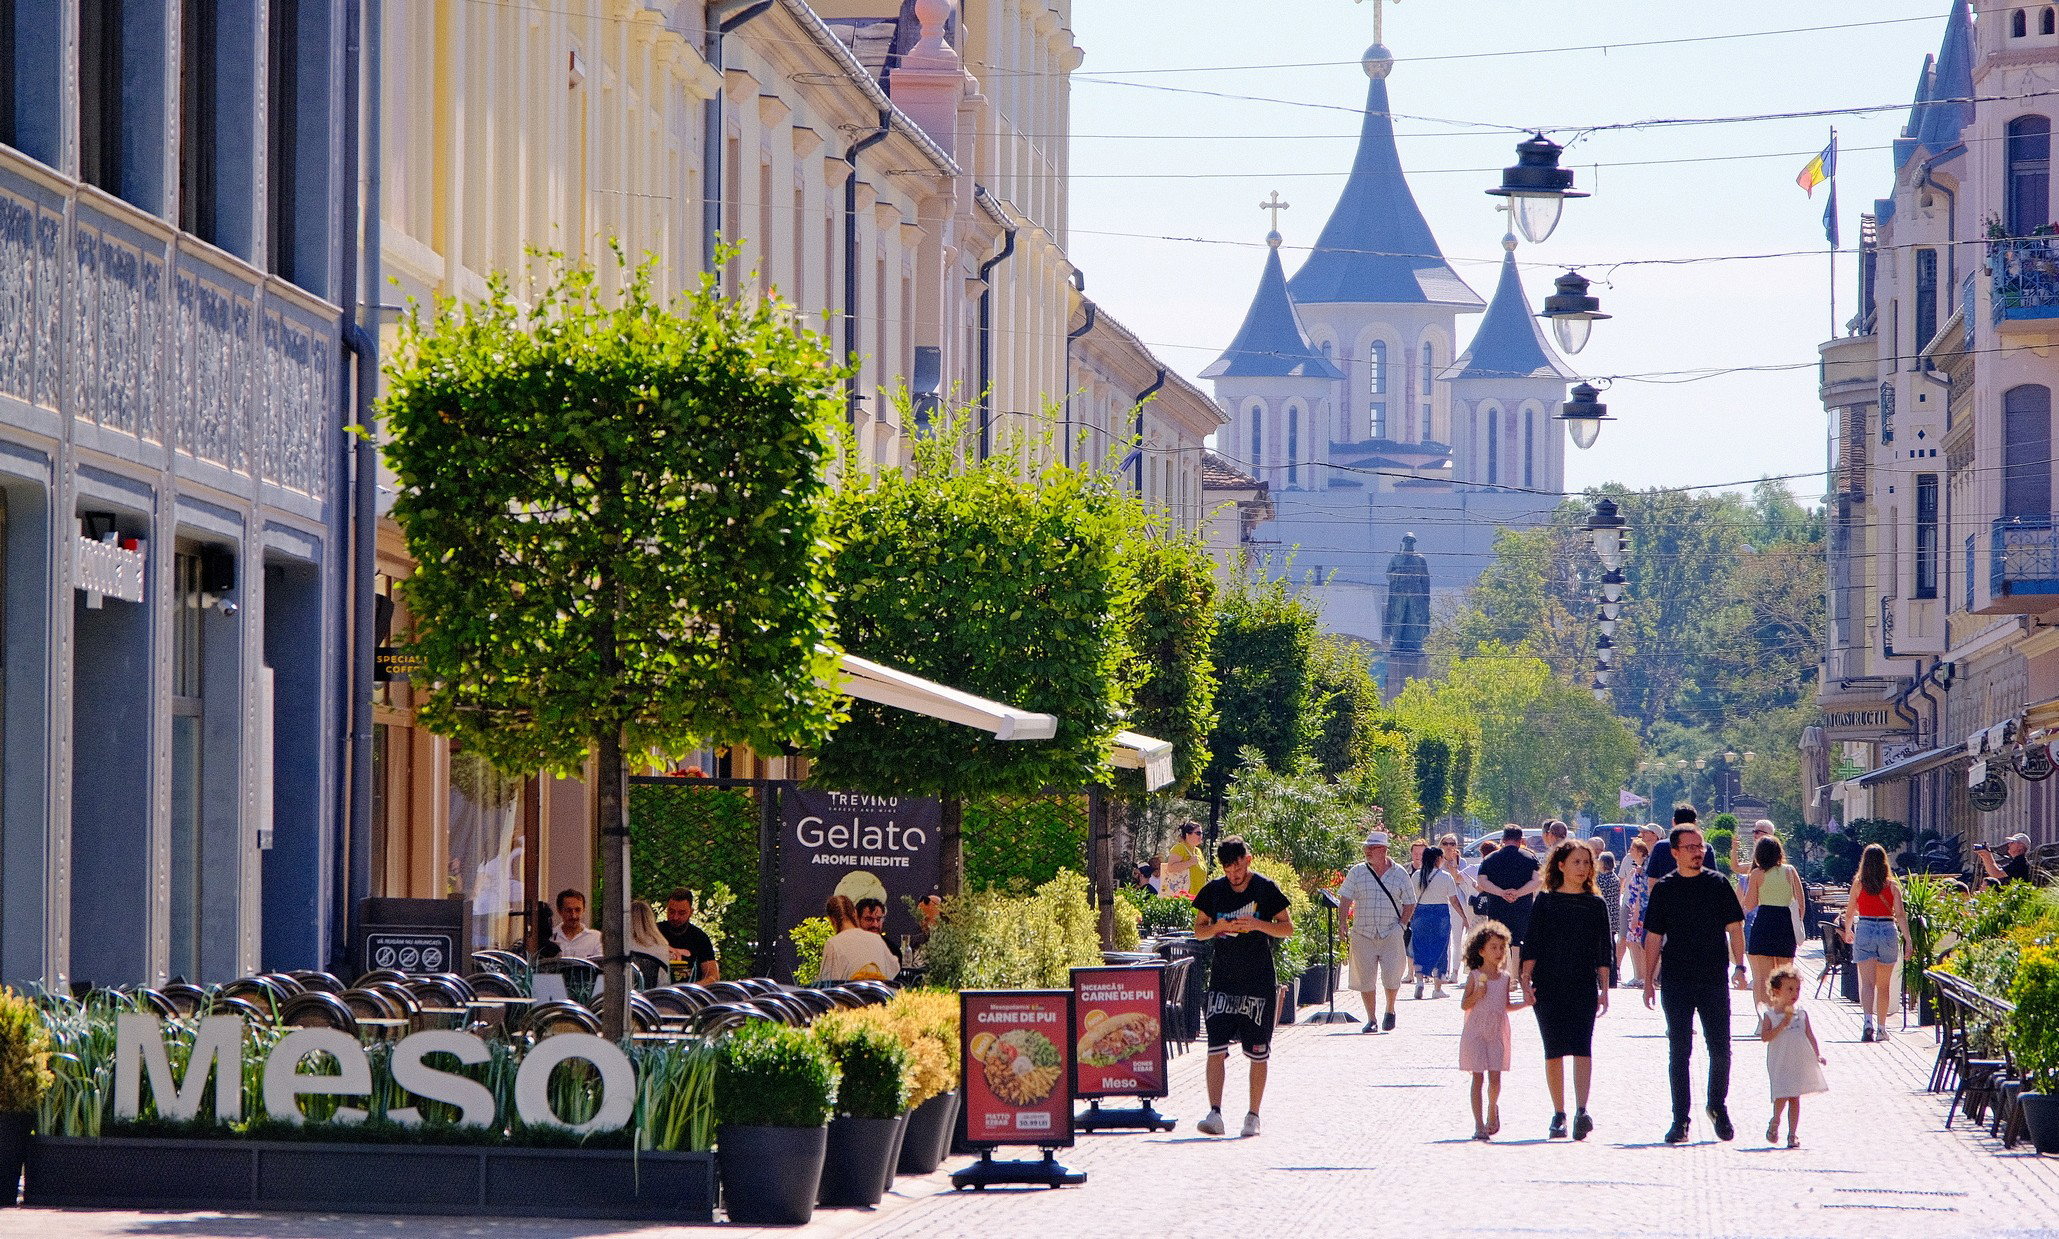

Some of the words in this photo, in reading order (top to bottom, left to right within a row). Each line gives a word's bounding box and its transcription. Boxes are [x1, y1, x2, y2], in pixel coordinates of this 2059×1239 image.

[796, 816, 926, 851] Gelato
[811, 854, 857, 866] AROME
[860, 855, 910, 867] INEDITE
[1081, 991, 1120, 1001] CARNE
[1120, 991, 1135, 1001] DE
[1135, 990, 1154, 1000] PUI
[978, 1012, 1018, 1023] CARNE
[1020, 1012, 1035, 1023] DE
[1037, 1012, 1056, 1023] PUI
[113, 1013, 637, 1132] Meso
[1102, 1077, 1138, 1088] Meso
